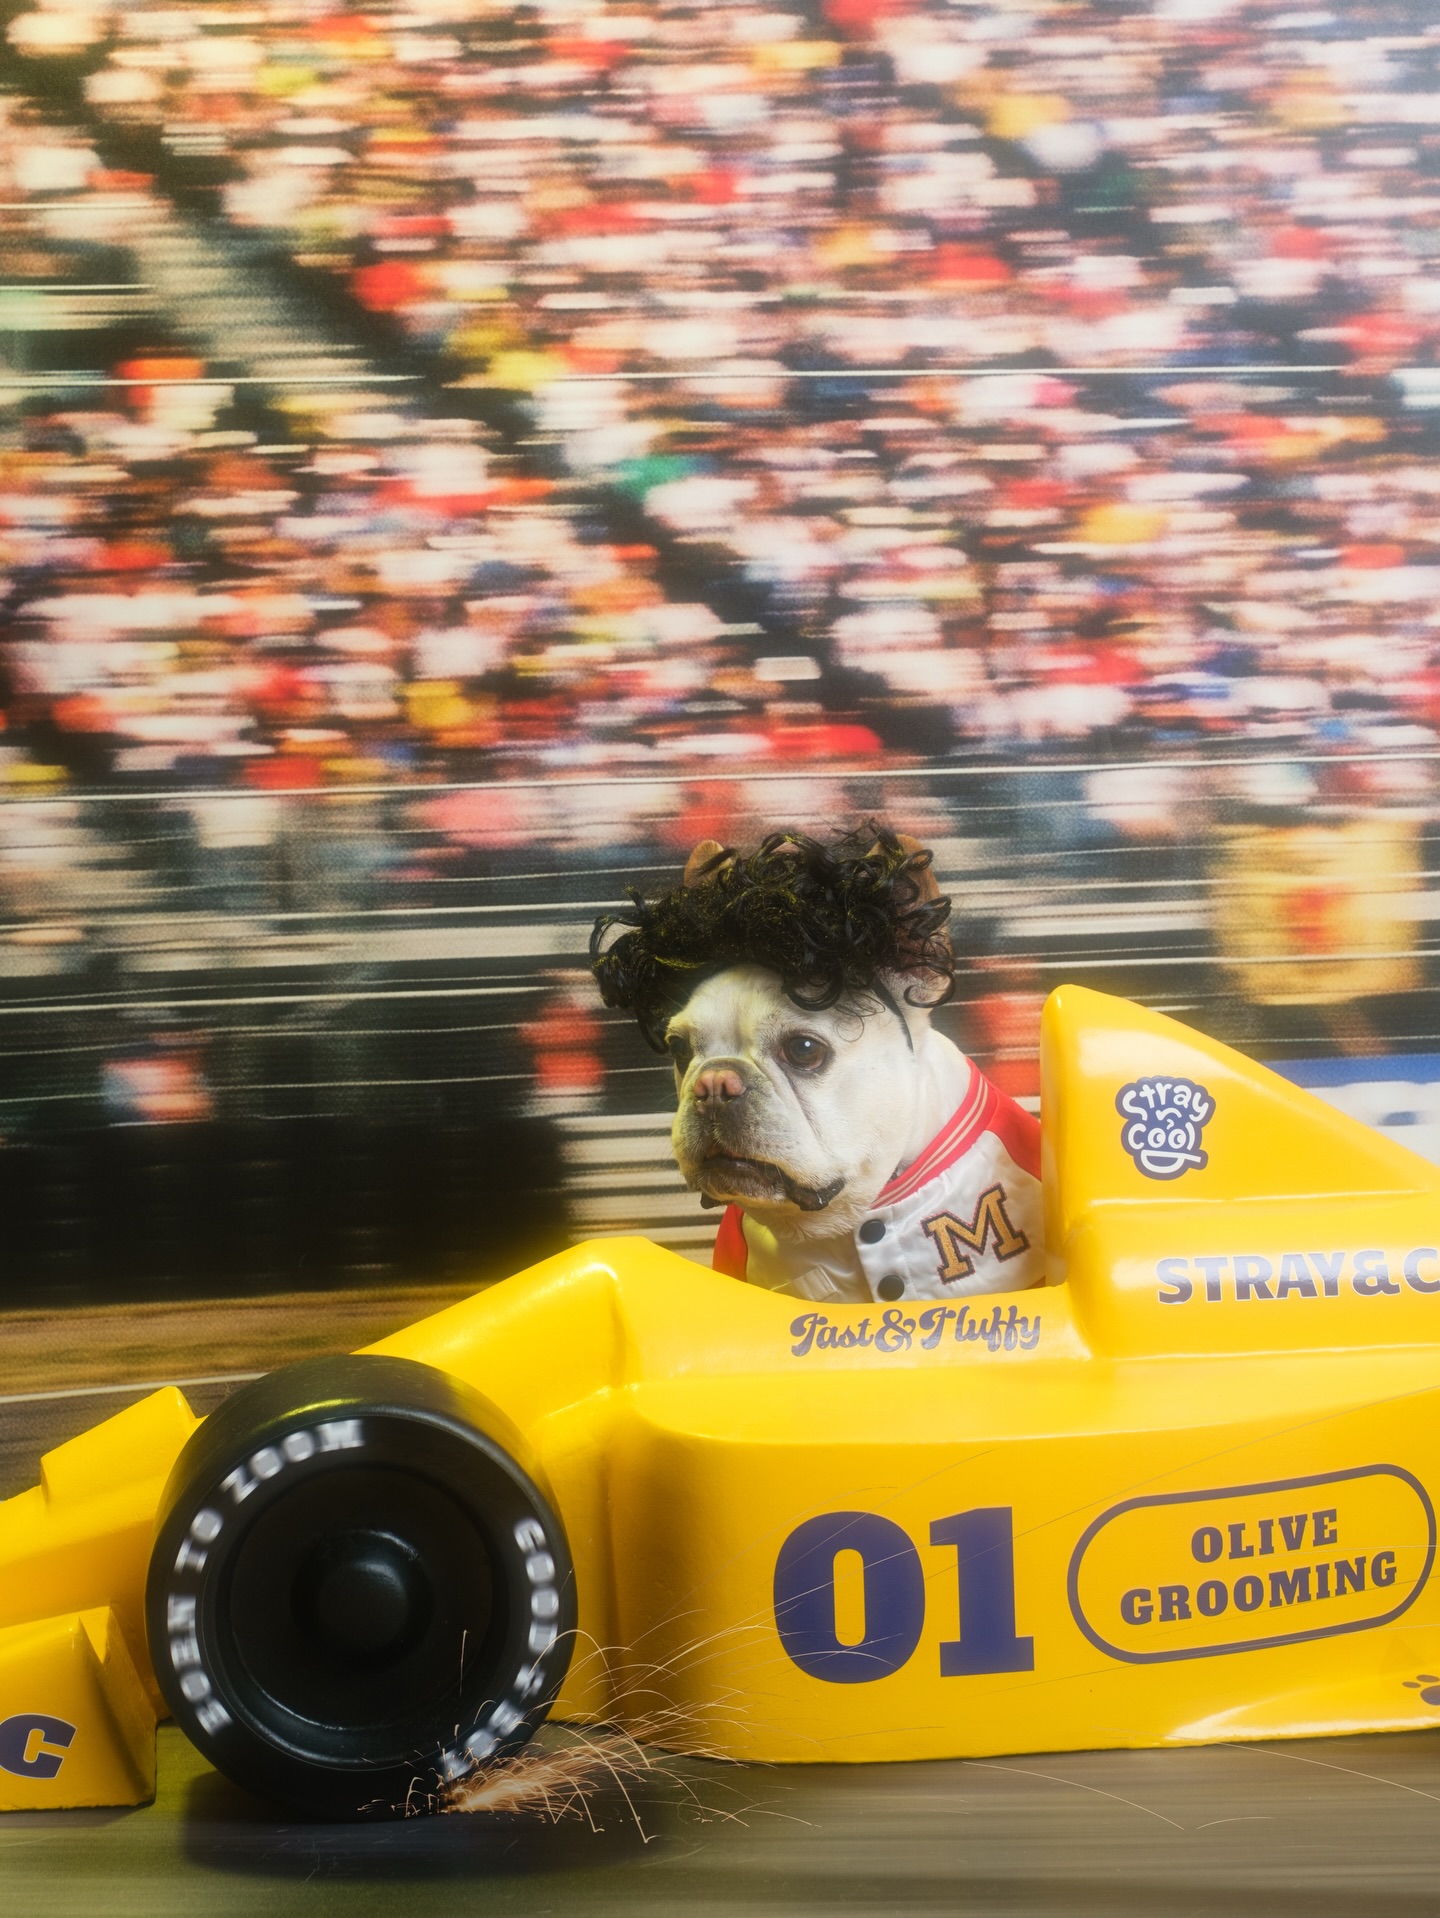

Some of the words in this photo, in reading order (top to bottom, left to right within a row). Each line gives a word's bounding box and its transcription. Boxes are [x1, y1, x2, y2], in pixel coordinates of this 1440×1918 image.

[1122, 1082, 1209, 1122] Stray
[921, 1182, 1031, 1285] M
[174, 1508, 223, 1574] TO
[219, 1419, 365, 1505] ZOOM
[1191, 1508, 1338, 1563] OLIVE
[773, 1506, 1034, 1684] 01
[1120, 1551, 1397, 1625] GROOMING
